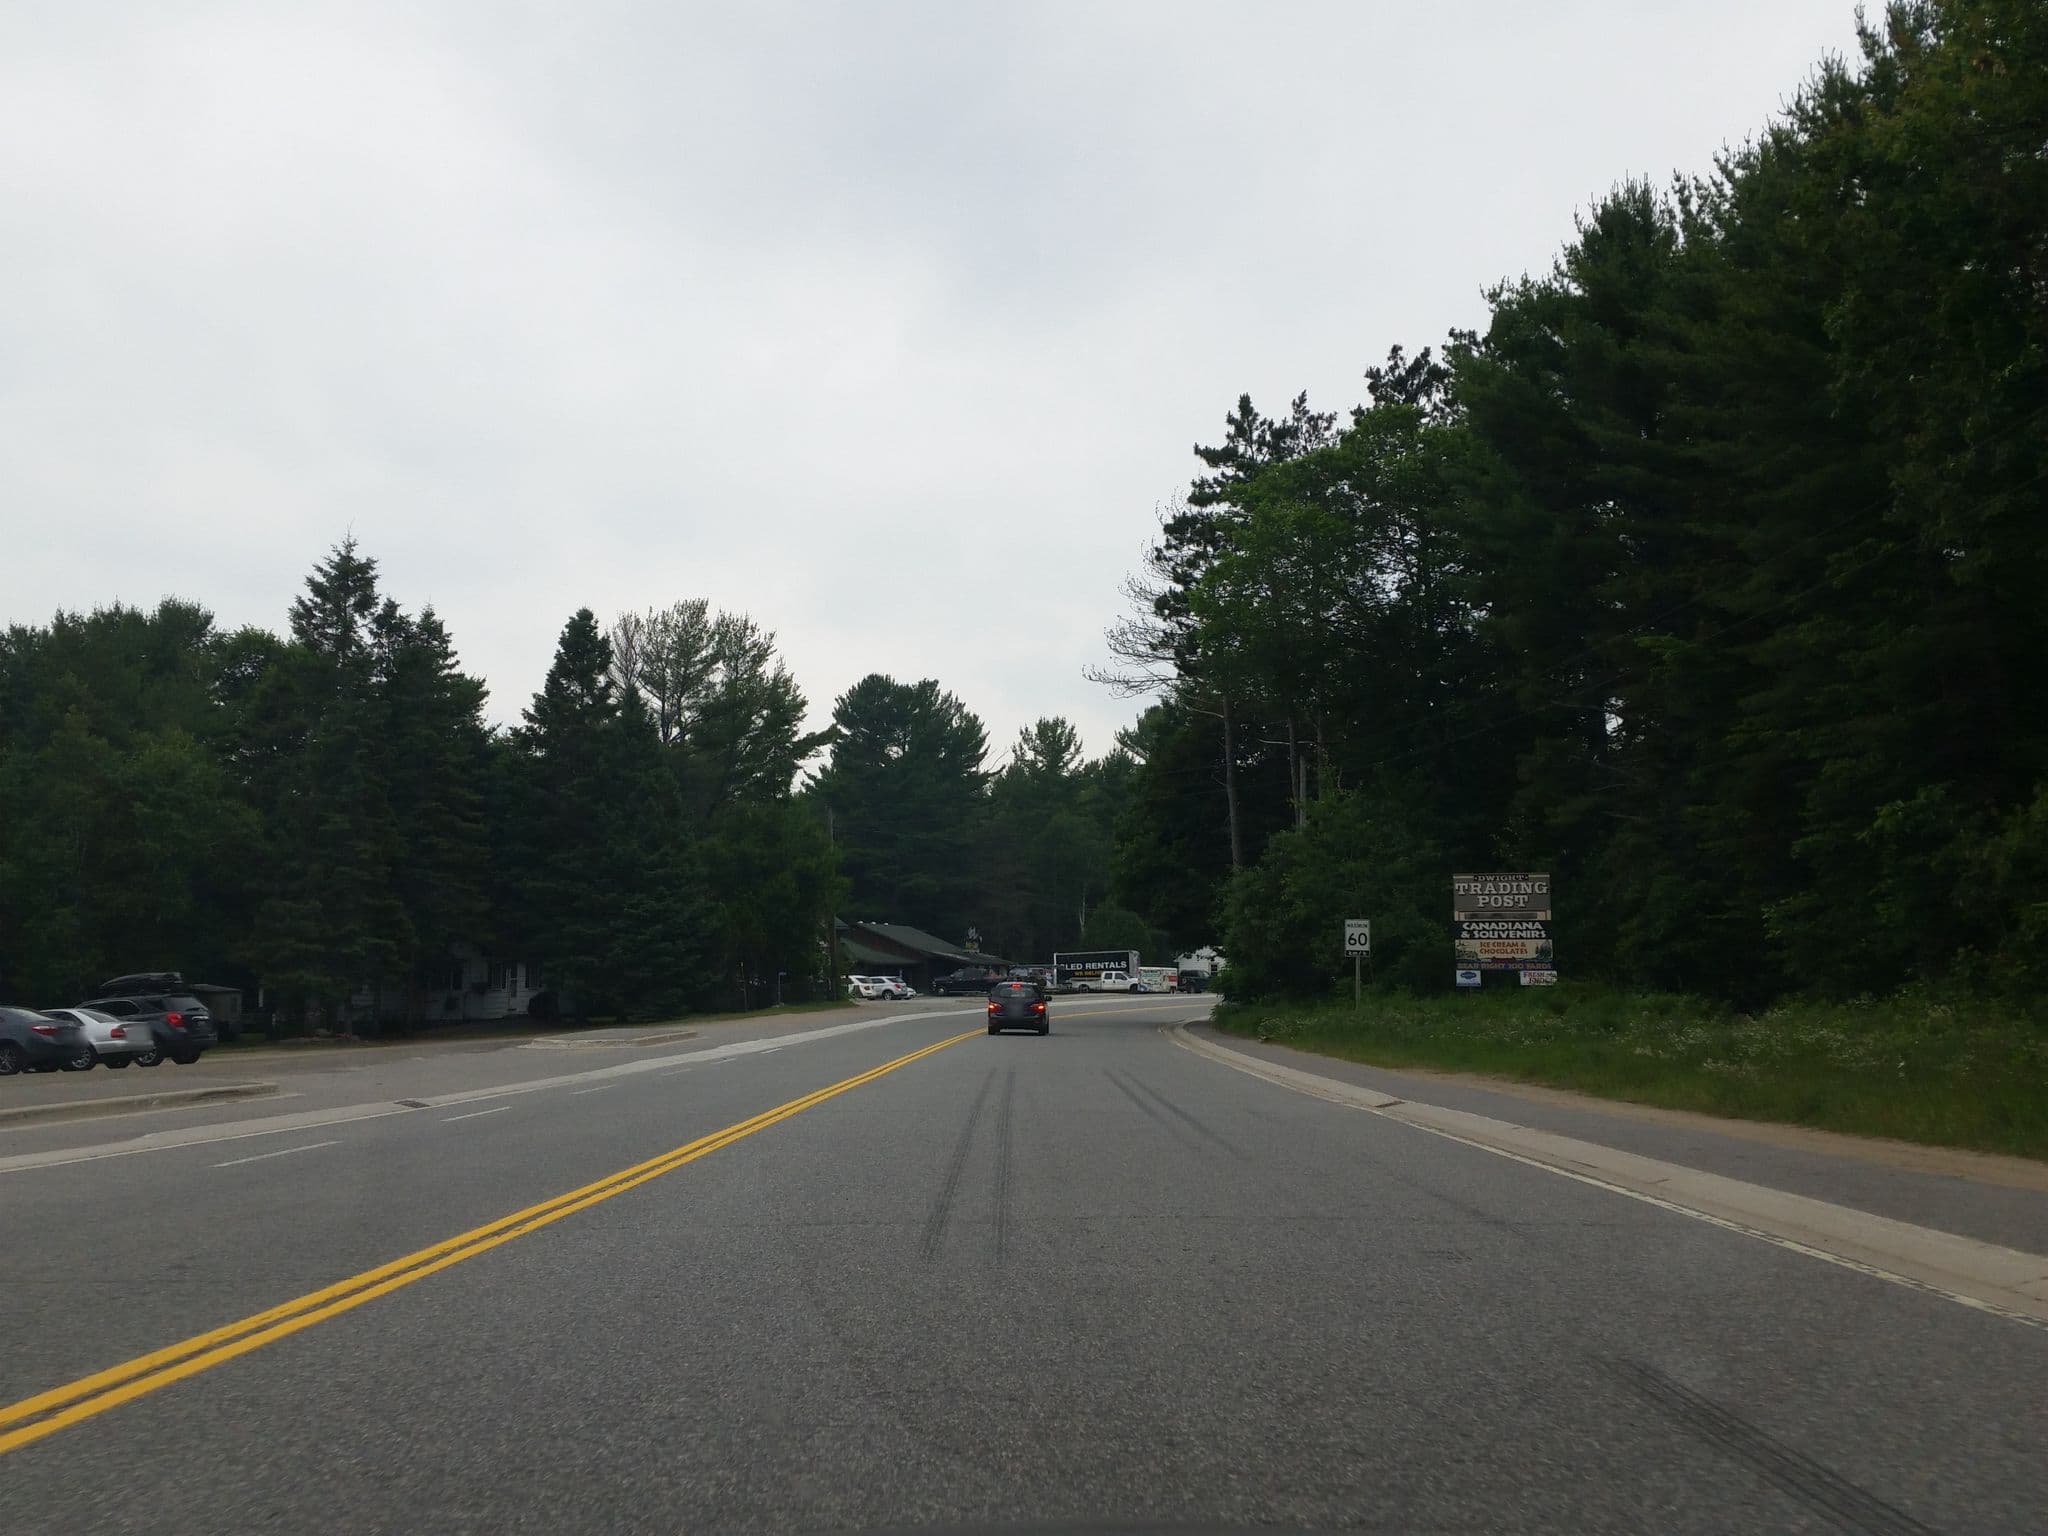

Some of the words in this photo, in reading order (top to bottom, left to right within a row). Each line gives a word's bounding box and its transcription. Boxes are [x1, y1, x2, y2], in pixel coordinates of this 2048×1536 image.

[1455, 882, 1548, 895] TRADING
[1477, 895, 1529, 907] POST
[1462, 922, 1543, 930] CANADIANA
[1348, 932, 1367, 946] 60
[1461, 931, 1470, 939] &
[1474, 930, 1546, 938] SOUVENIRS
[1085, 961, 1127, 970] RENTALS
